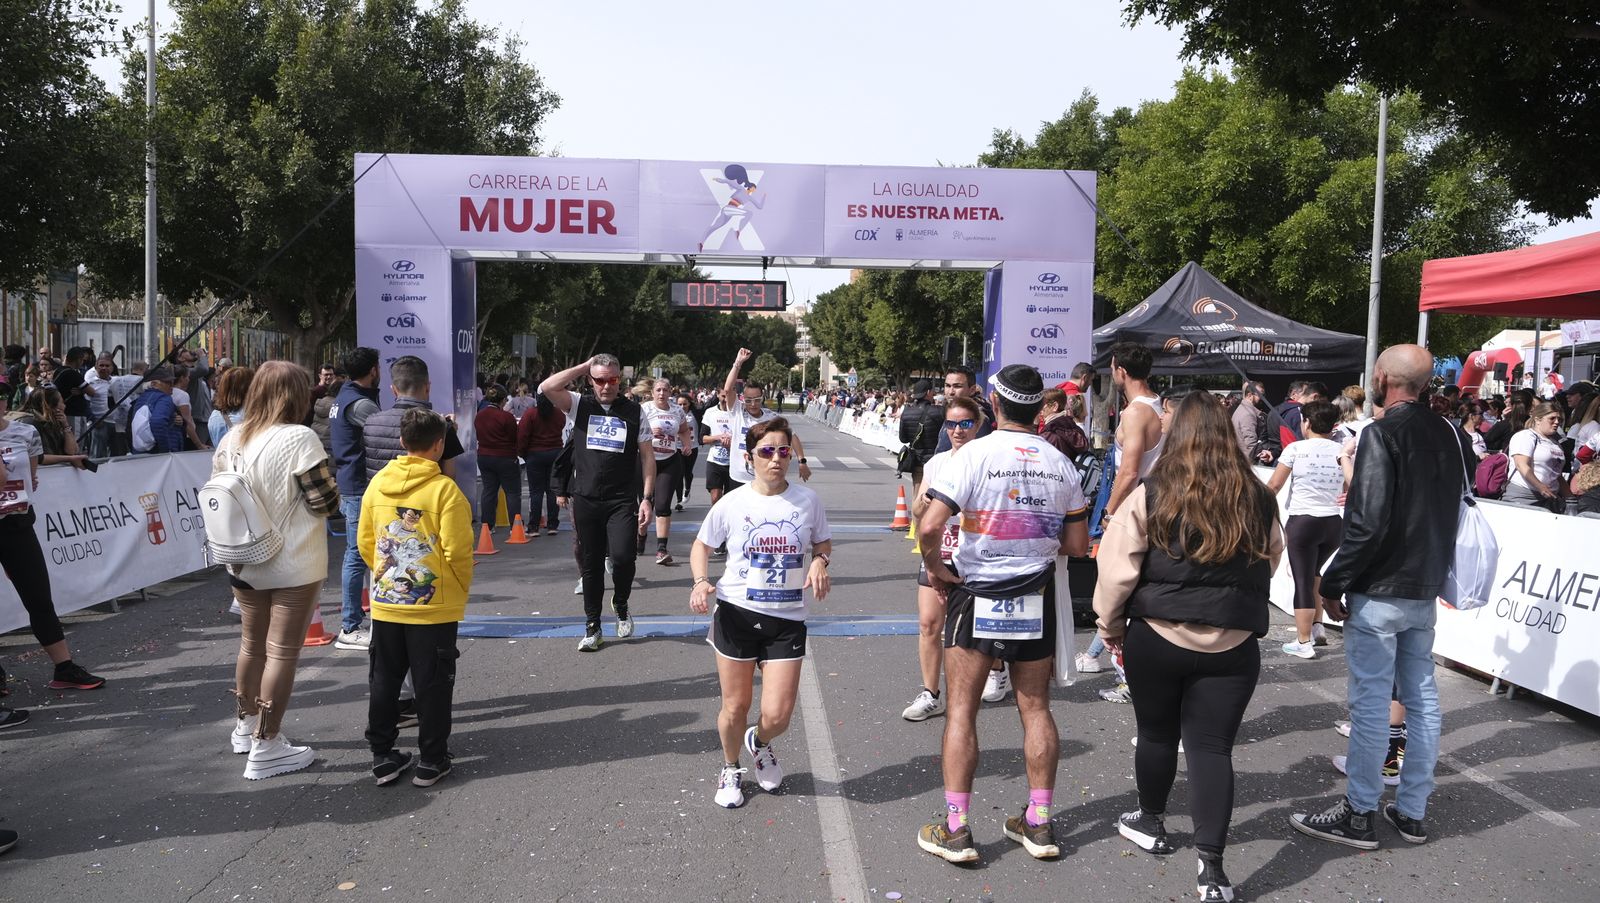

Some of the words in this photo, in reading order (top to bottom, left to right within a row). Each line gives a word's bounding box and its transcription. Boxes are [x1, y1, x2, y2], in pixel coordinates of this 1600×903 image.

[469, 174, 552, 190] CARRERA
[557, 175, 580, 191] DE
[586, 176, 608, 191] LA
[873, 182, 892, 196] LA
[897, 182, 979, 198] IGUALDAD
[459, 196, 618, 236] MUJER
[847, 204, 868, 218] ES
[871, 205, 951, 220] NUESTRA
[953, 207, 1004, 221] META.
[393, 294, 427, 302] cajamar
[687, 283, 784, 308] 00:35:31
[1038, 306, 1071, 314] cajamar
[396, 336, 427, 344] vithas
[1196, 339, 1310, 357] cruzandolameta
[1039, 346, 1068, 355] vithas
[595, 426, 617, 436] 445
[658, 439, 672, 447] 512
[45, 497, 139, 541] ALMERÍA
[759, 536, 787, 546] MINI
[941, 536, 959, 548] 02
[51, 539, 103, 566] CIUDAD
[766, 569, 787, 584] 21
[991, 597, 1024, 613] 261
[1495, 597, 1567, 635] CIUDAD
